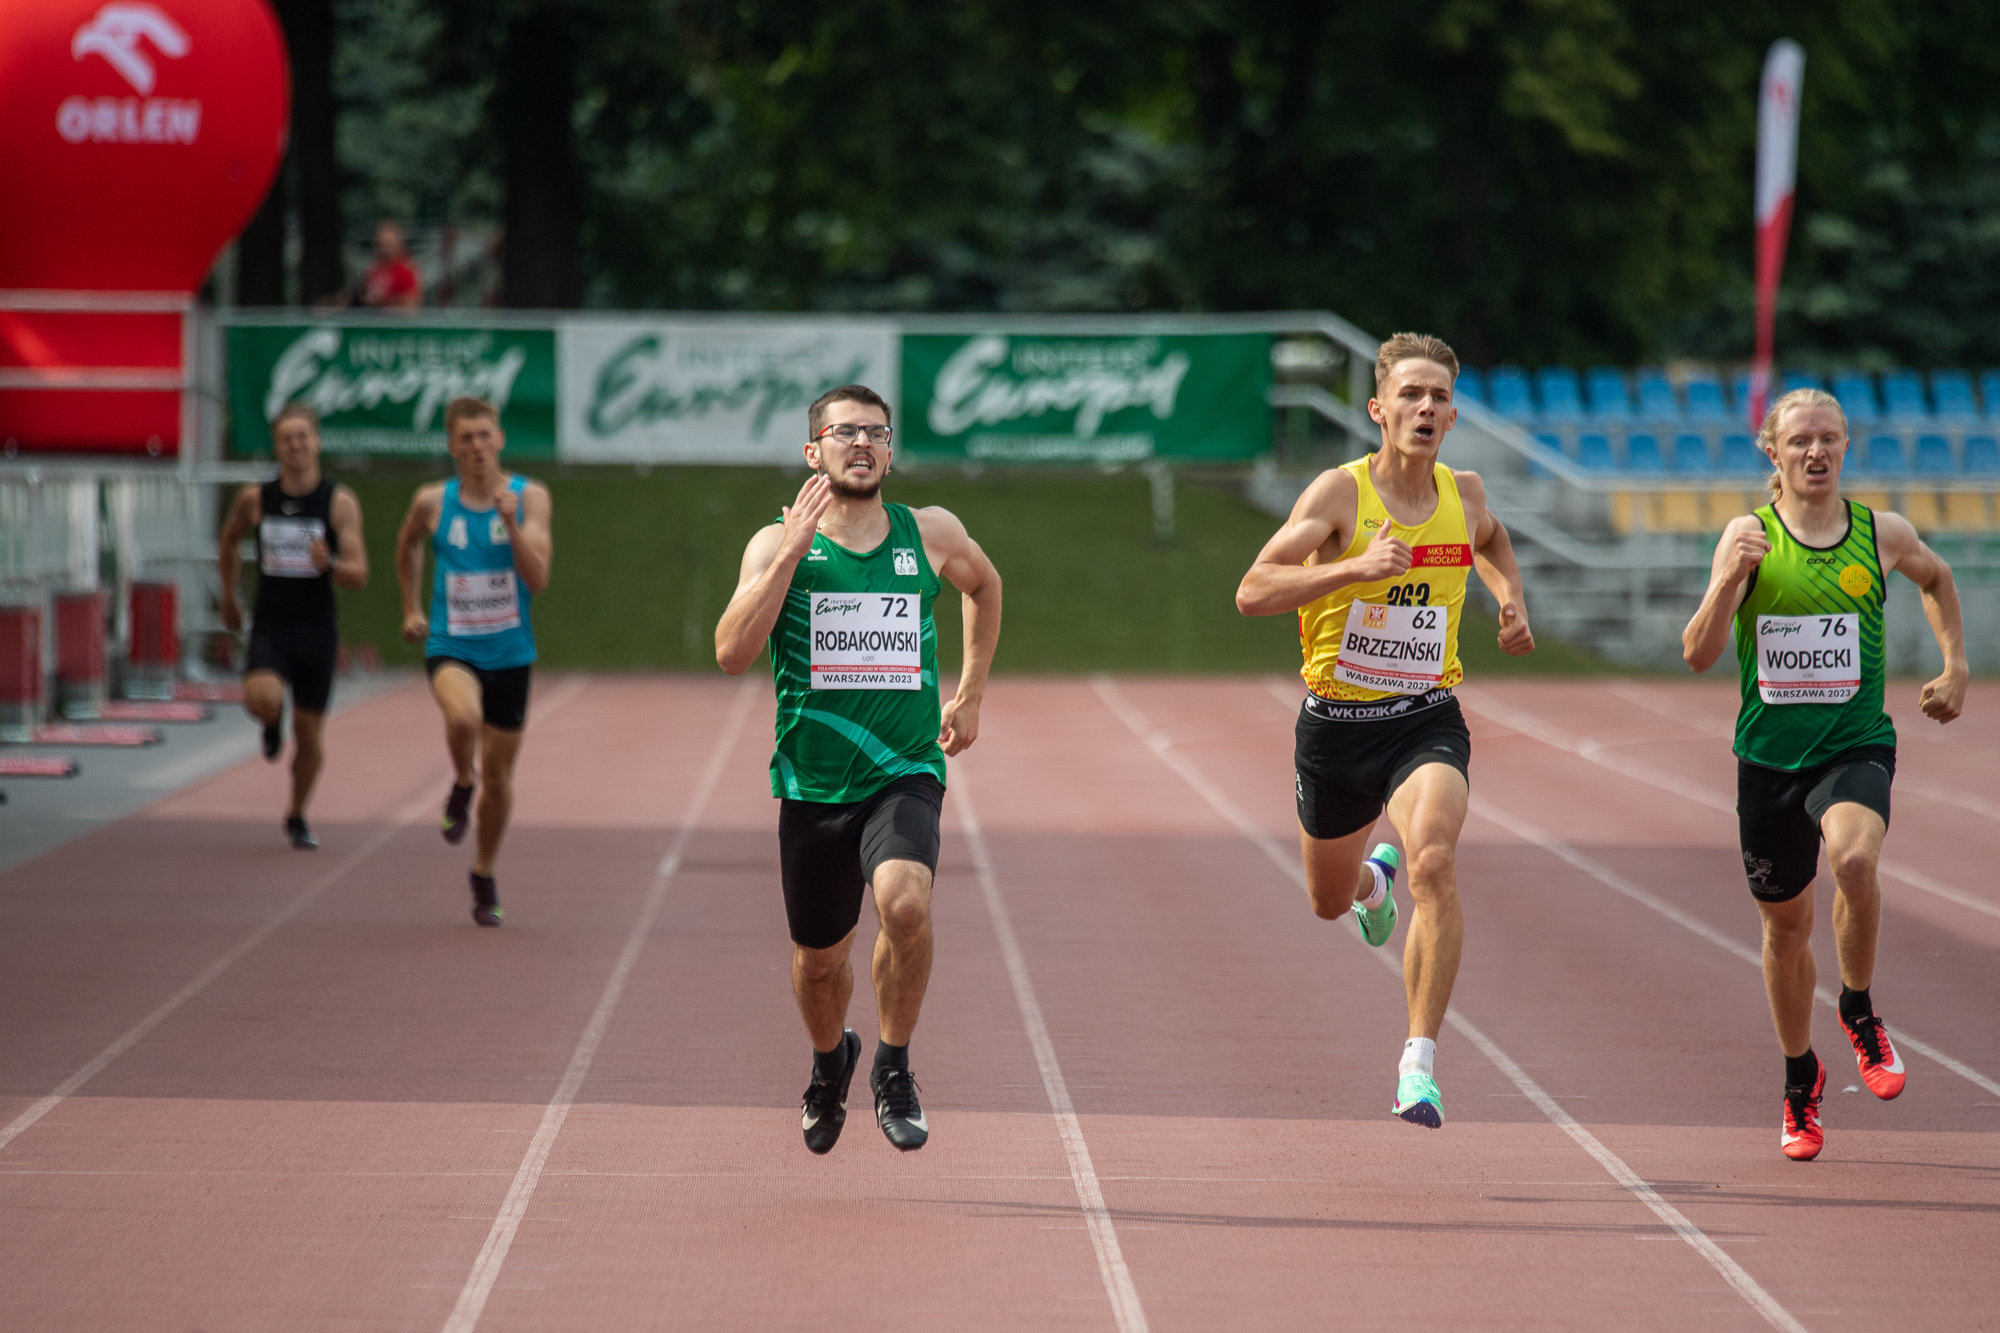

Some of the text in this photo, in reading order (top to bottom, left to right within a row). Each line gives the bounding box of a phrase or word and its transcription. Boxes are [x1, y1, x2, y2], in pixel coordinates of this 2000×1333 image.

[56, 95, 202, 144] ORLEN
[446, 515, 470, 550] 4
[1423, 556, 1462, 565] WROCŁAW
[1427, 546, 1462, 556] MKS MOS
[815, 597, 862, 616] Europol
[880, 597, 908, 618] 72
[1412, 610, 1437, 630] 62
[1760, 620, 1802, 638] Europol
[1819, 617, 1847, 638] 76
[815, 630, 918, 653] ROBAKOWSKI
[1346, 632, 1441, 662] BRZEZIŃSKI
[1766, 648, 1851, 670] WODECKI
[823, 674, 912, 684] WARSZAWA 2023
[1345, 670, 1430, 690] WARSZAWA 2023
[1766, 689, 1851, 698] WARSZAWA 2023
